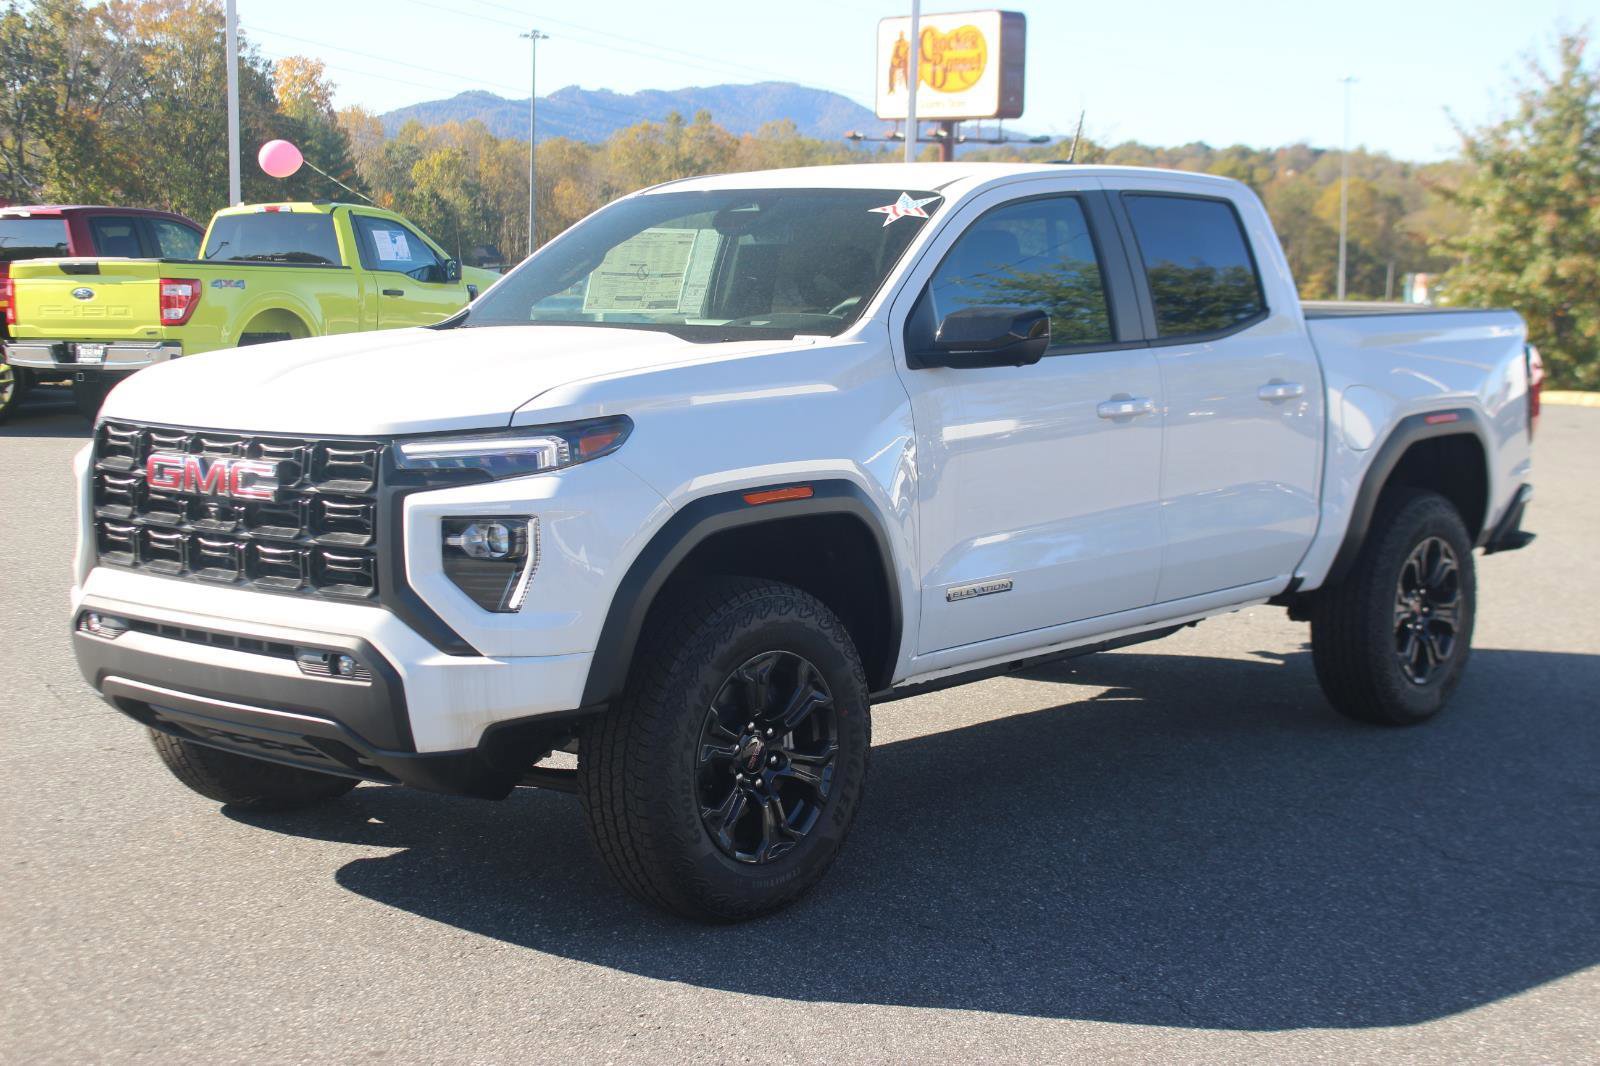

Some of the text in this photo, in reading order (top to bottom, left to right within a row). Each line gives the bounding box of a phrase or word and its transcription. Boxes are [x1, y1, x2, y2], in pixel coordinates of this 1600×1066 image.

[38, 304, 133, 318] F-150
[146, 453, 279, 502] GMC
[950, 582, 1010, 599] ELEVATION
